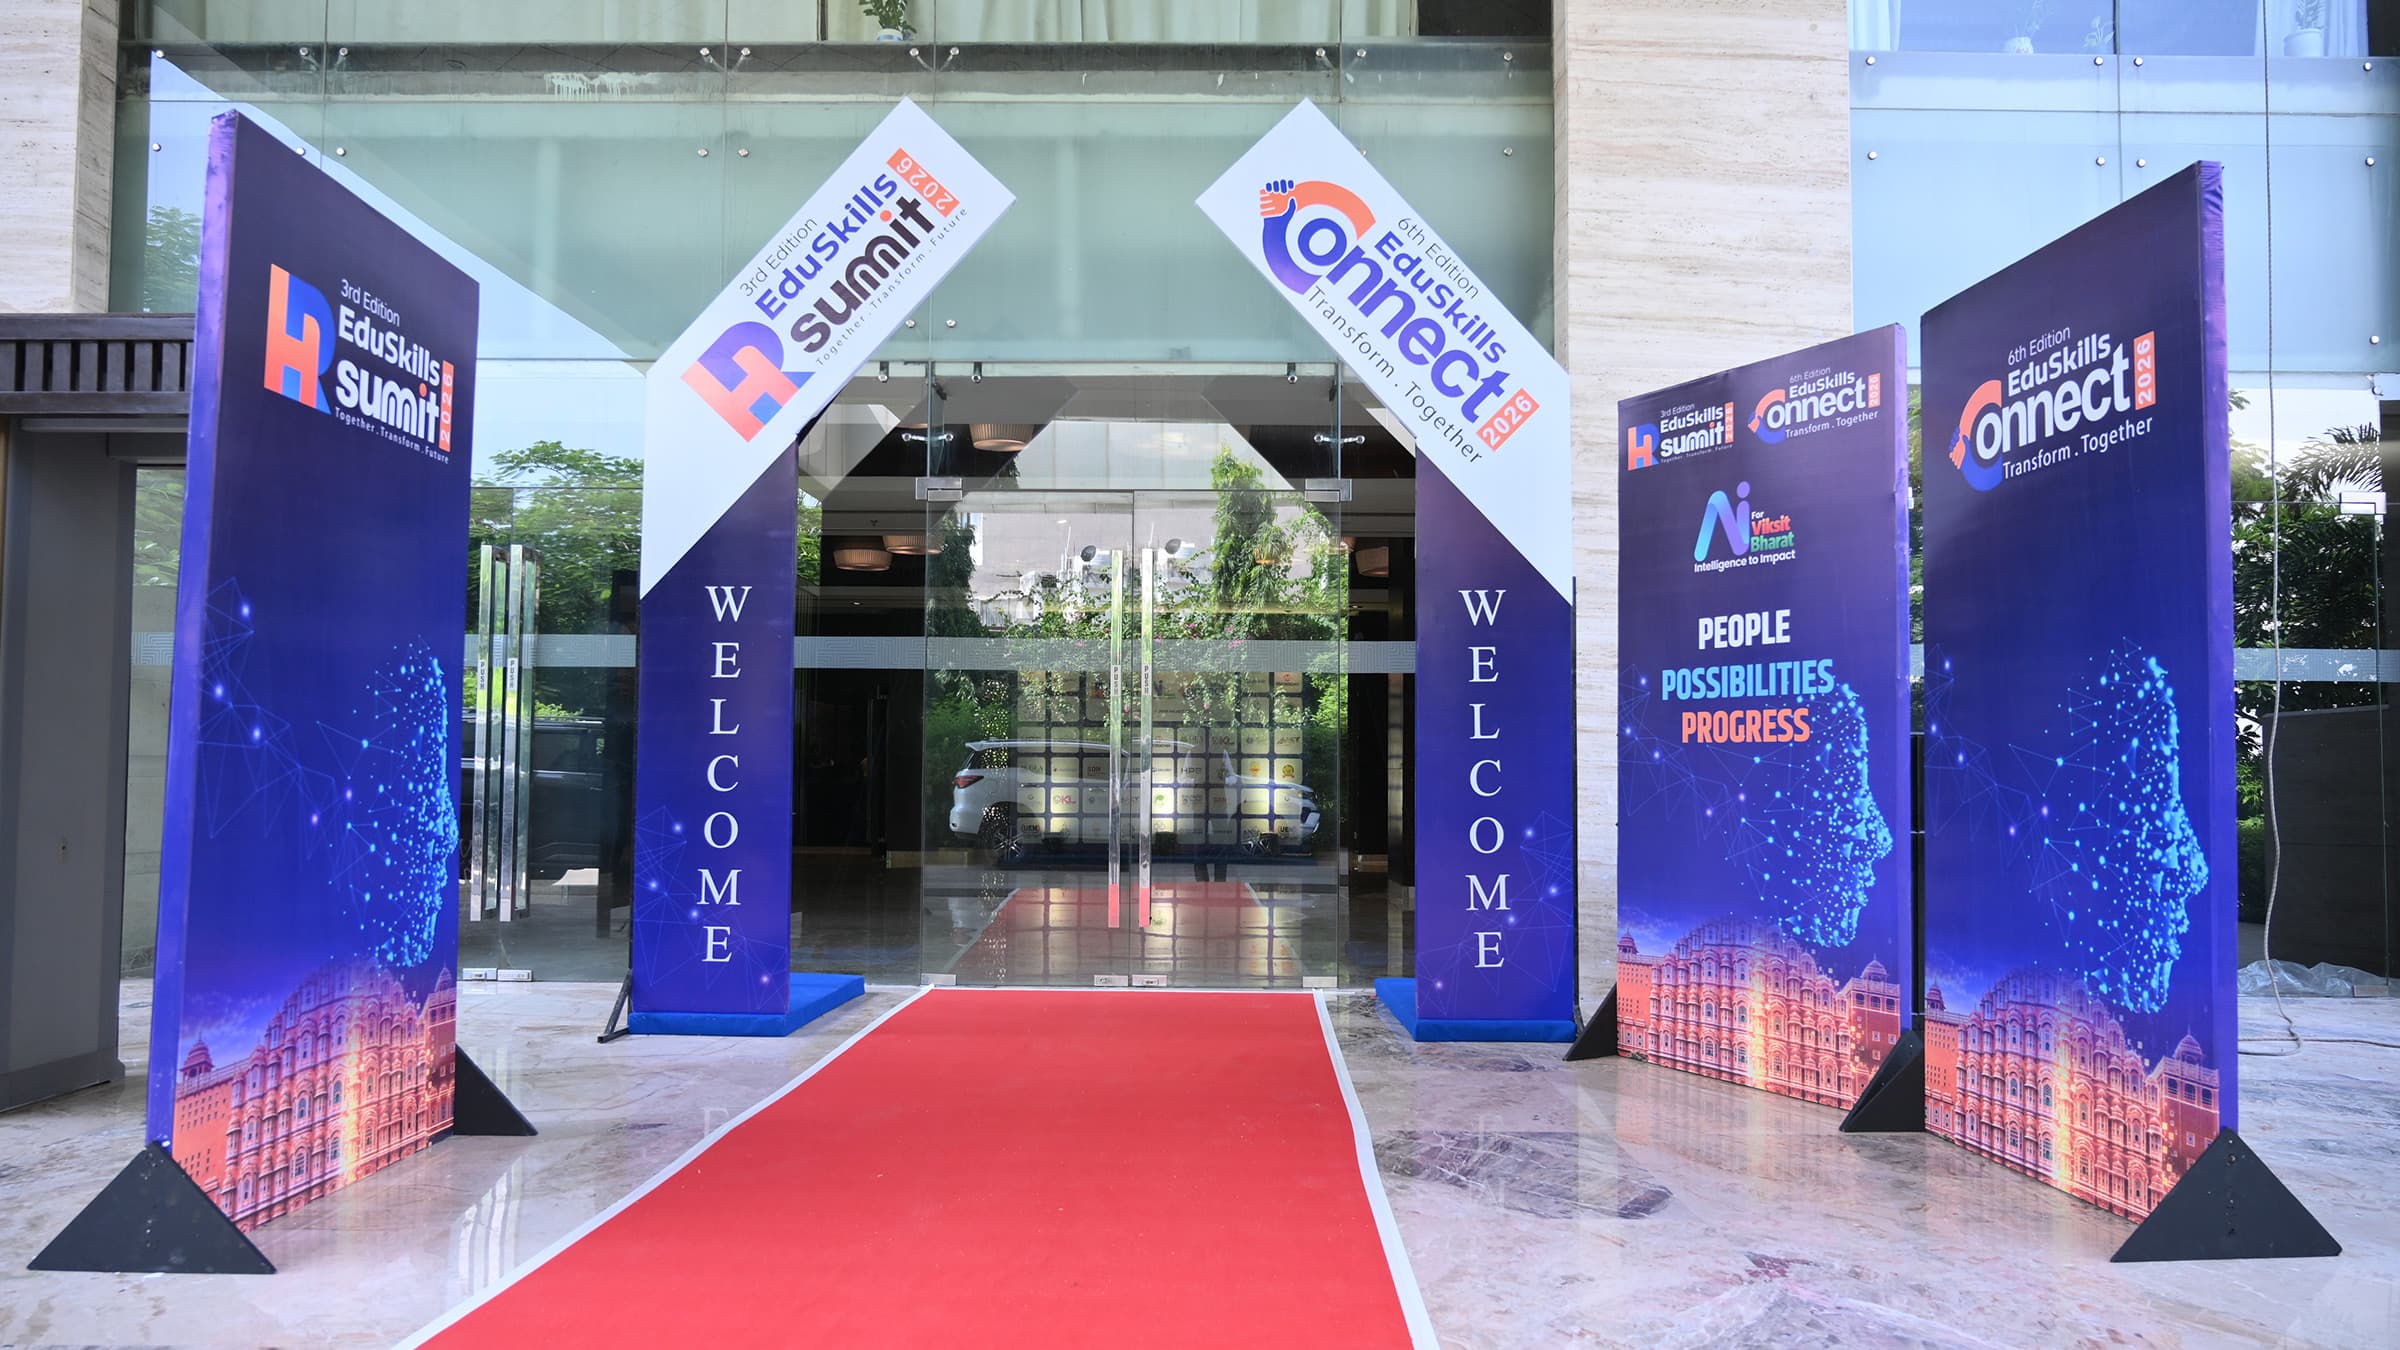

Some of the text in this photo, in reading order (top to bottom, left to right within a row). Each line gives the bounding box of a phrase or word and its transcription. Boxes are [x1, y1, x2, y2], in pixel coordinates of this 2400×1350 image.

[895, 156, 954, 211] 2026
[740, 217, 818, 297] 3rd Edition
[754, 173, 898, 320] EduSkills
[790, 195, 935, 353] summit
[1397, 216, 1479, 300] 6th Edition
[340, 278, 401, 328] 3rd Edition
[816, 207, 968, 366] Together Transform Future
[1374, 230, 1507, 364] EduSkills
[338, 304, 441, 387] EduSkills
[2007, 326, 2071, 366] 6th Edition
[2008, 333, 2111, 397] EduSkills
[2136, 338, 2152, 405] 2026
[335, 359, 440, 444] summit
[1306, 285, 1483, 464] Transform Together
[1789, 367, 1831, 384] 6th Edition
[1789, 371, 1855, 399] EduSkills
[334, 406, 450, 464] Together Transform Future
[440, 373, 453, 443] 2026
[1481, 394, 1533, 449] 2026
[1660, 403, 1695, 418] 3rd Edition
[1660, 406, 1724, 433] EduSkills
[1785, 411, 1879, 439] Transform Together
[1660, 421, 1725, 457] summit
[2002, 416, 2153, 480] Transform Together
[1750, 531, 1795, 553] Bharat
[1751, 511, 1764, 520] For
[1751, 515, 1791, 536] Viksit
[1694, 549, 1796, 573] Intelligence to Impact
[1698, 609, 1791, 650] PEOPLE
[1662, 658, 1835, 701] POSSIBILITIES
[1682, 708, 1811, 744] PROGRESS
[696, 585, 753, 963] WELCOME
[1457, 589, 1511, 969] WELCOME
